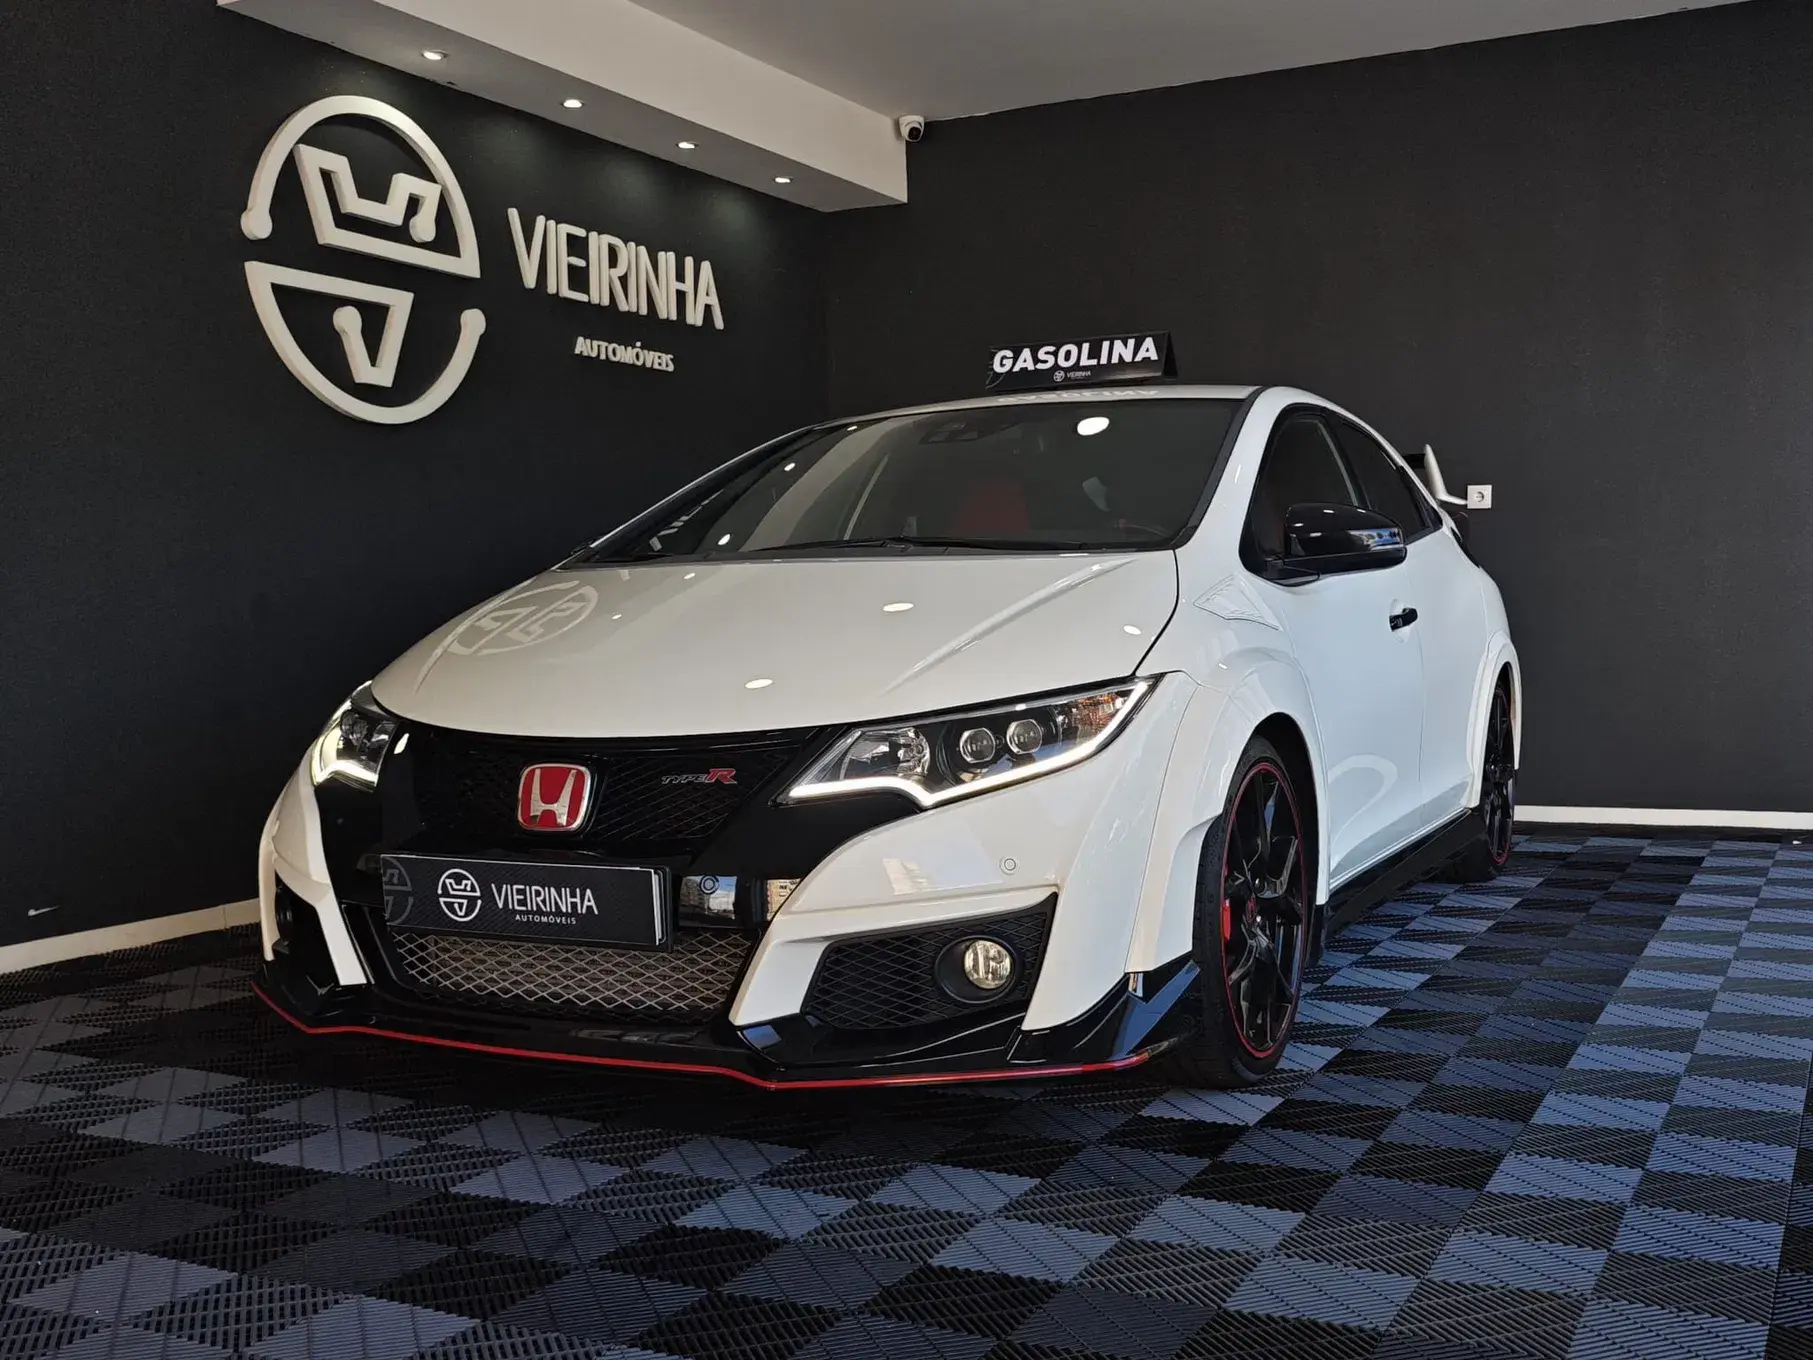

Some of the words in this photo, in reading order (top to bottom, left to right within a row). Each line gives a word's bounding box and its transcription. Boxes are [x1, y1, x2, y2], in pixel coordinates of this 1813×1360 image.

[508, 207, 724, 330] VIEIRINHA
[574, 336, 675, 372] AUTOMÓVEIS
[993, 337, 1158, 373] GASOLINA
[491, 883, 598, 915] VIEIRINHA
[515, 914, 577, 925] AUTOMÓVEIS
